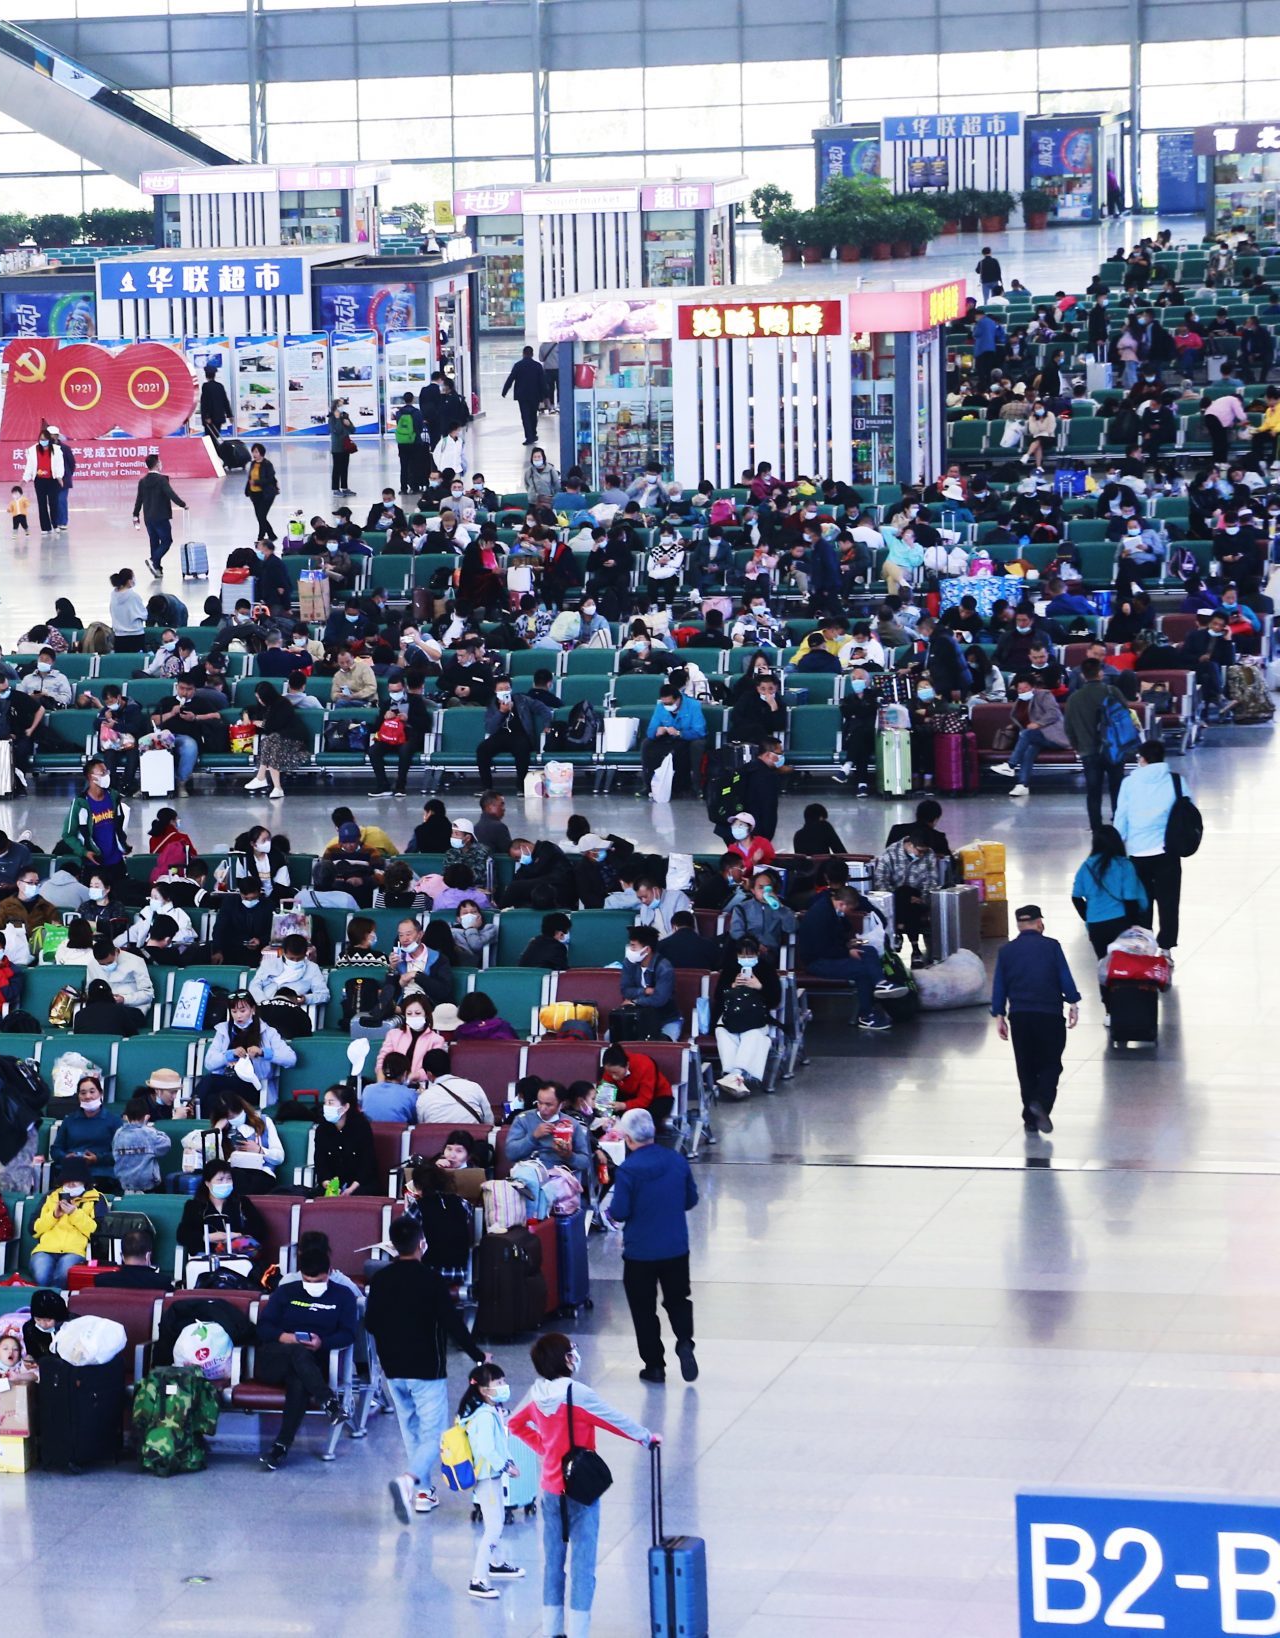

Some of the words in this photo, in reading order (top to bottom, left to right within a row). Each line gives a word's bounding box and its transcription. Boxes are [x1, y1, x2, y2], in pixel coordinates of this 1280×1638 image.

[912, 114, 1006, 137] 华联超市
[654, 186, 699, 208] 超市
[147, 263, 280, 293] 华联超市
[70, 384, 92, 394] 1921
[137, 383, 160, 393] 2021
[91, 470, 109, 478] Party
[1030, 1522, 1280, 1635] B2-B
